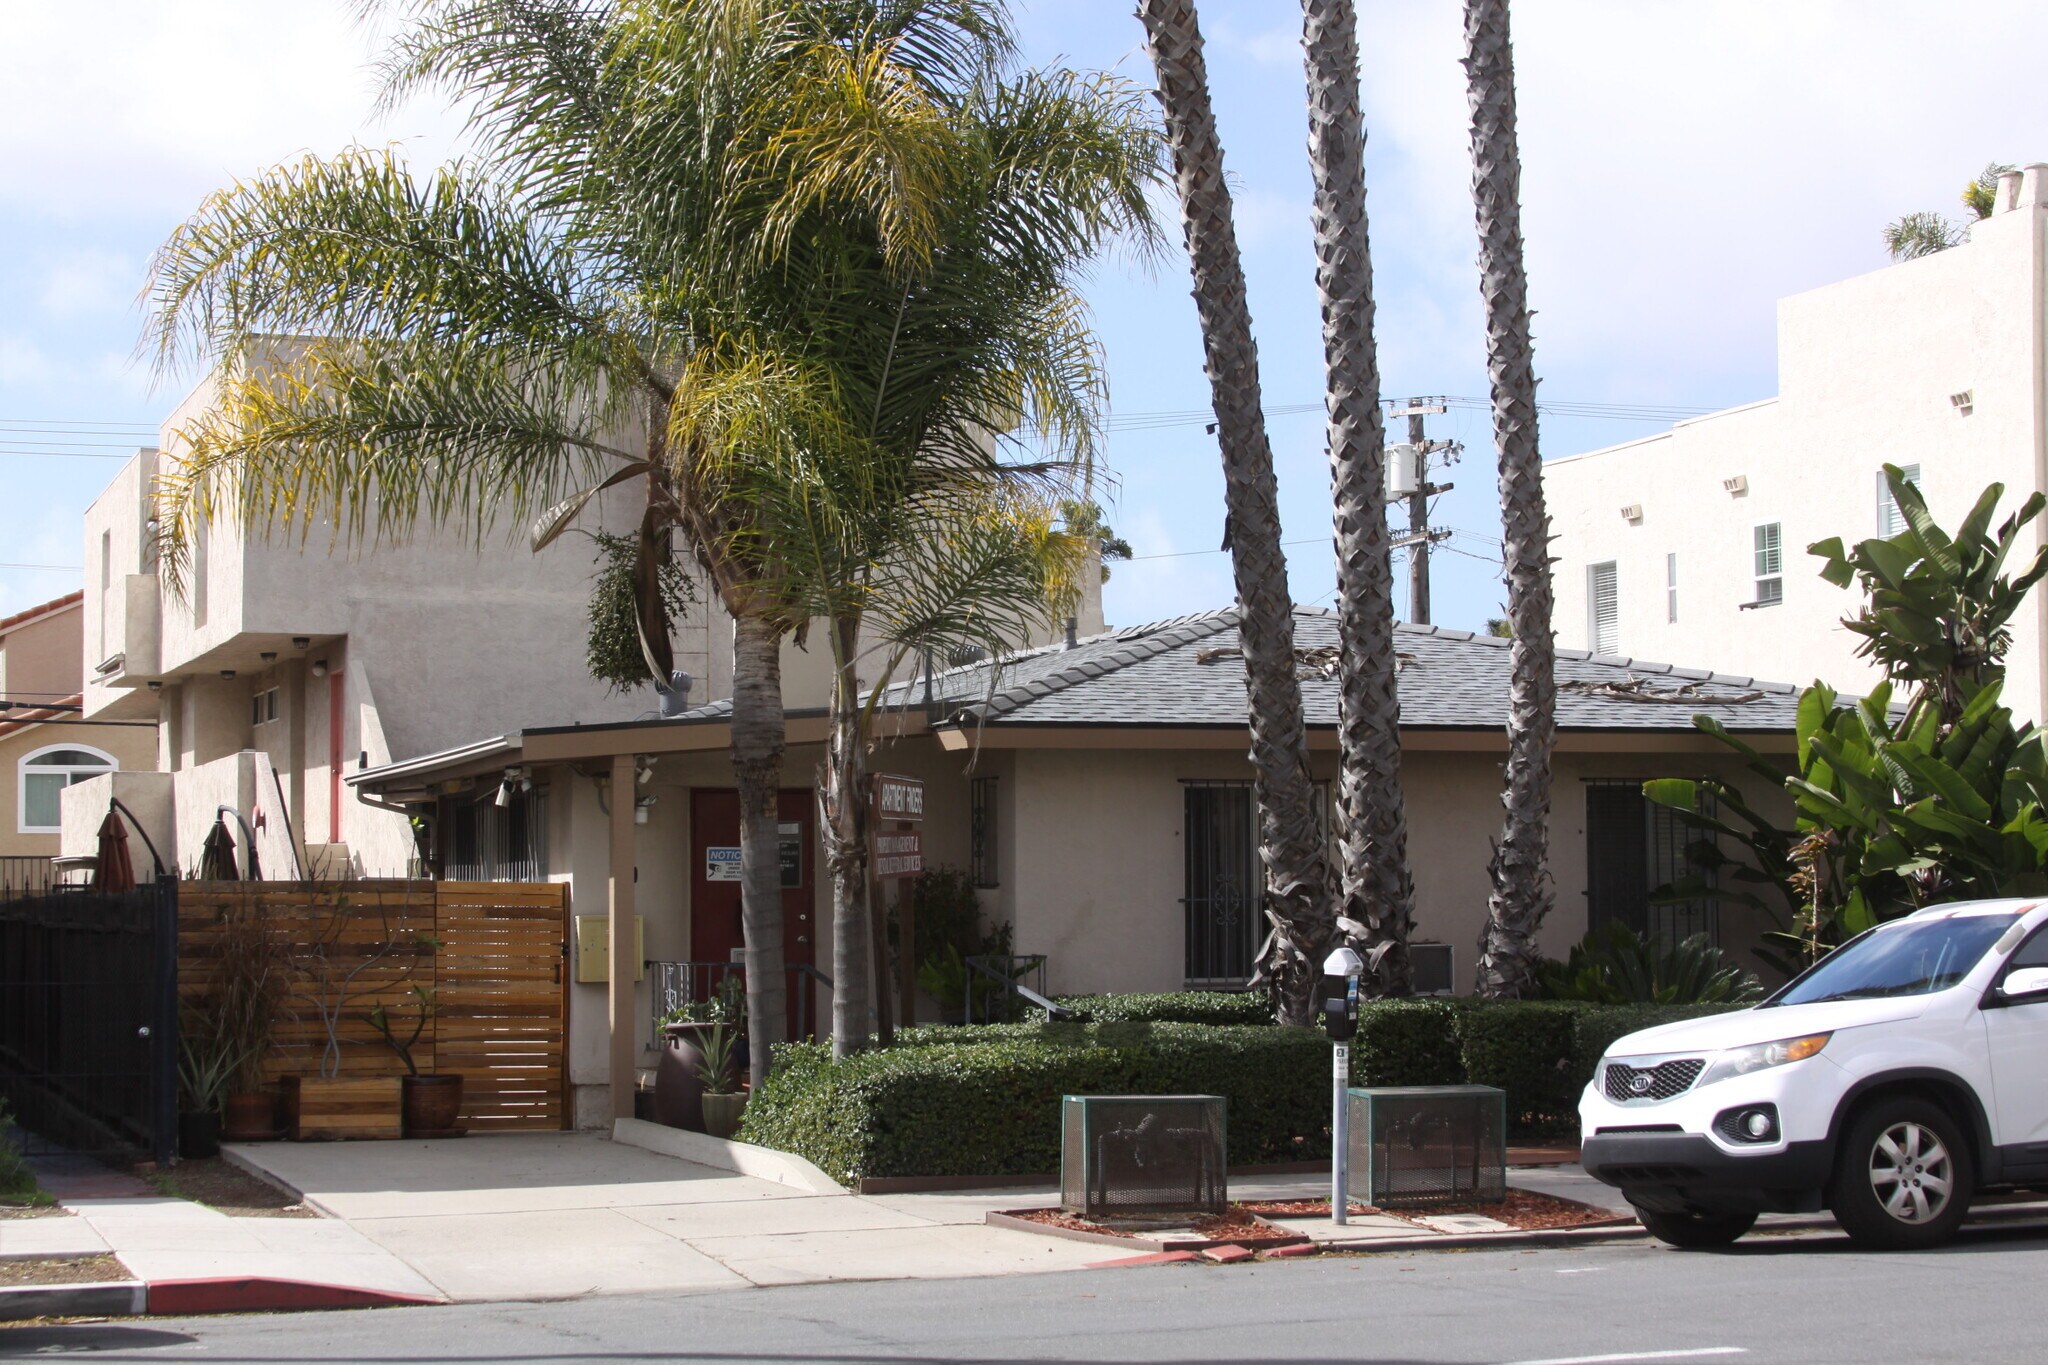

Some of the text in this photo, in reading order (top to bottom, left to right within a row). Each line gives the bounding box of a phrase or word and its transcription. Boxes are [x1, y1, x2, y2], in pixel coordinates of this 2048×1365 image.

[882, 783, 923, 815] APARTMENT FINDERS
[710, 850, 741, 860] NOTIC
